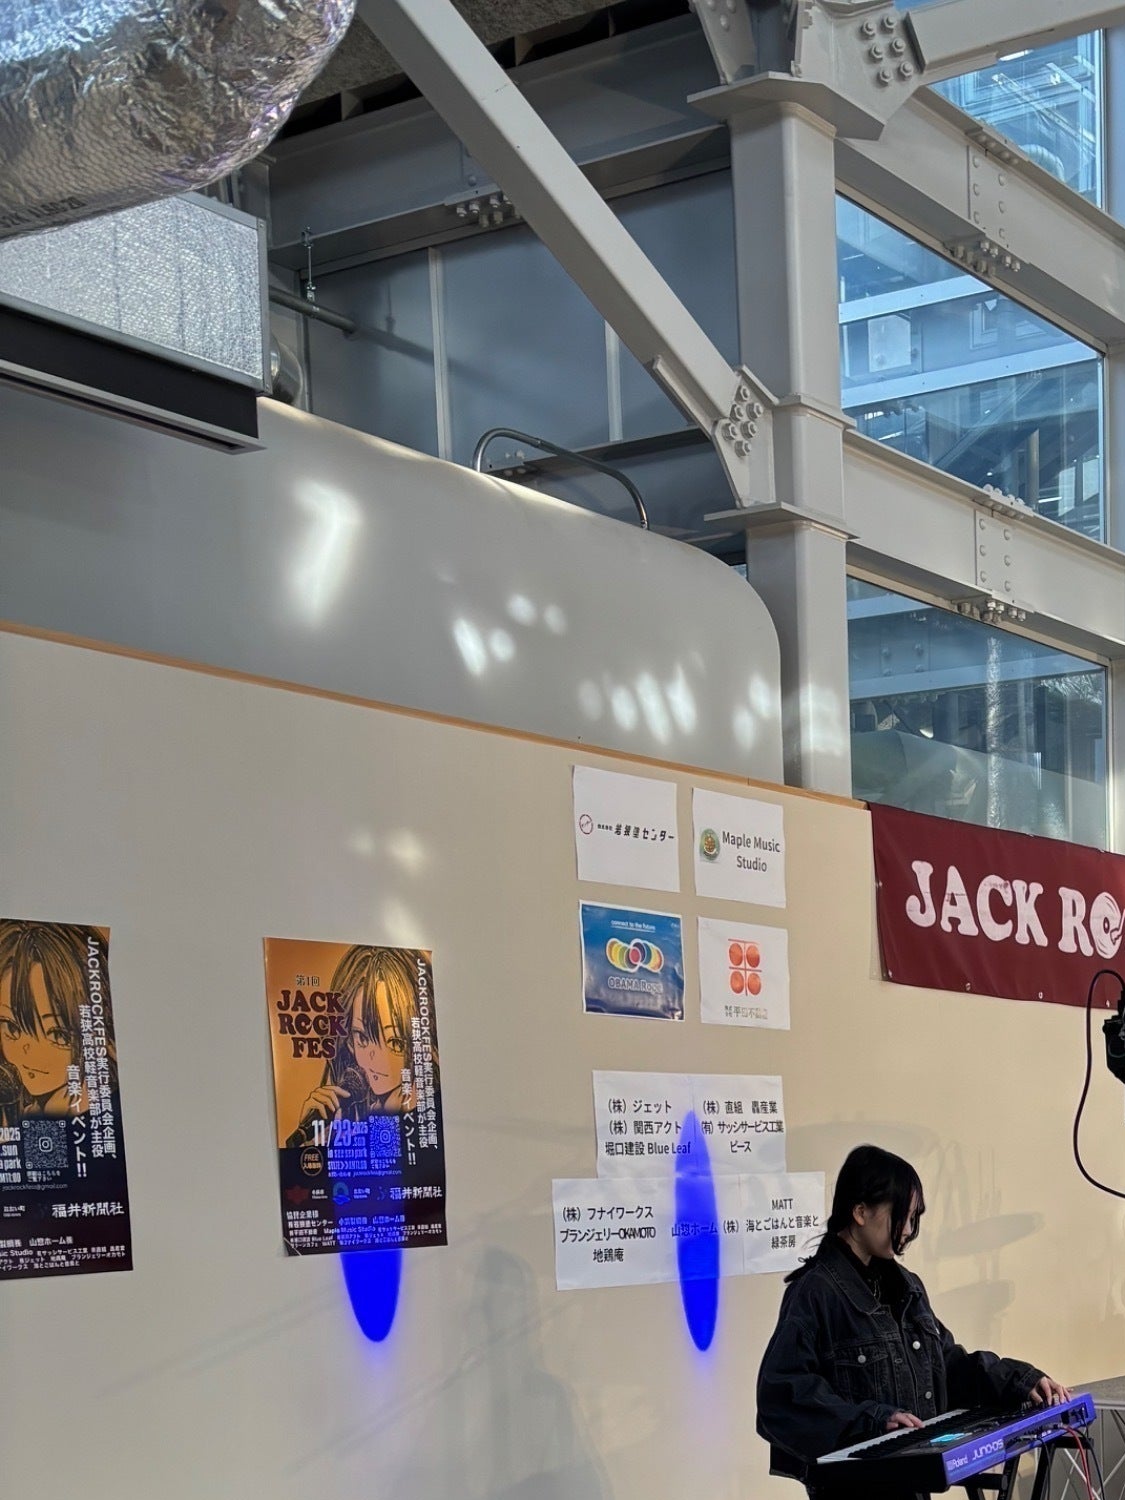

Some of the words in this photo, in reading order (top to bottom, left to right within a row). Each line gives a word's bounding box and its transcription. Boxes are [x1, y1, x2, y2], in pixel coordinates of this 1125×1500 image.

[722, 831, 752, 849] Maple
[753, 836, 781, 853] Music
[736, 855, 767, 872] Studio
[906, 860, 1049, 947] JACK
[608, 976, 640, 991] OBAMA
[277, 990, 346, 1014] JACK
[277, 1013, 348, 1038] ROCK
[291, 1036, 337, 1059] FES
[311, 1119, 351, 1147] 11/23
[352, 1121, 369, 1134] 2025
[605, 1141, 645, 1156] 堀口建設
[647, 1142, 670, 1154] Blue
[671, 1141, 691, 1154] Leaf
[4, 1157, 22, 1171] park
[390, 1186, 443, 1200] 福井新聞社
[51, 1202, 125, 1218] 福井新聞社
[771, 1198, 794, 1210] MATT
[746, 1215, 819, 1232] 海とごはんと音楽と
